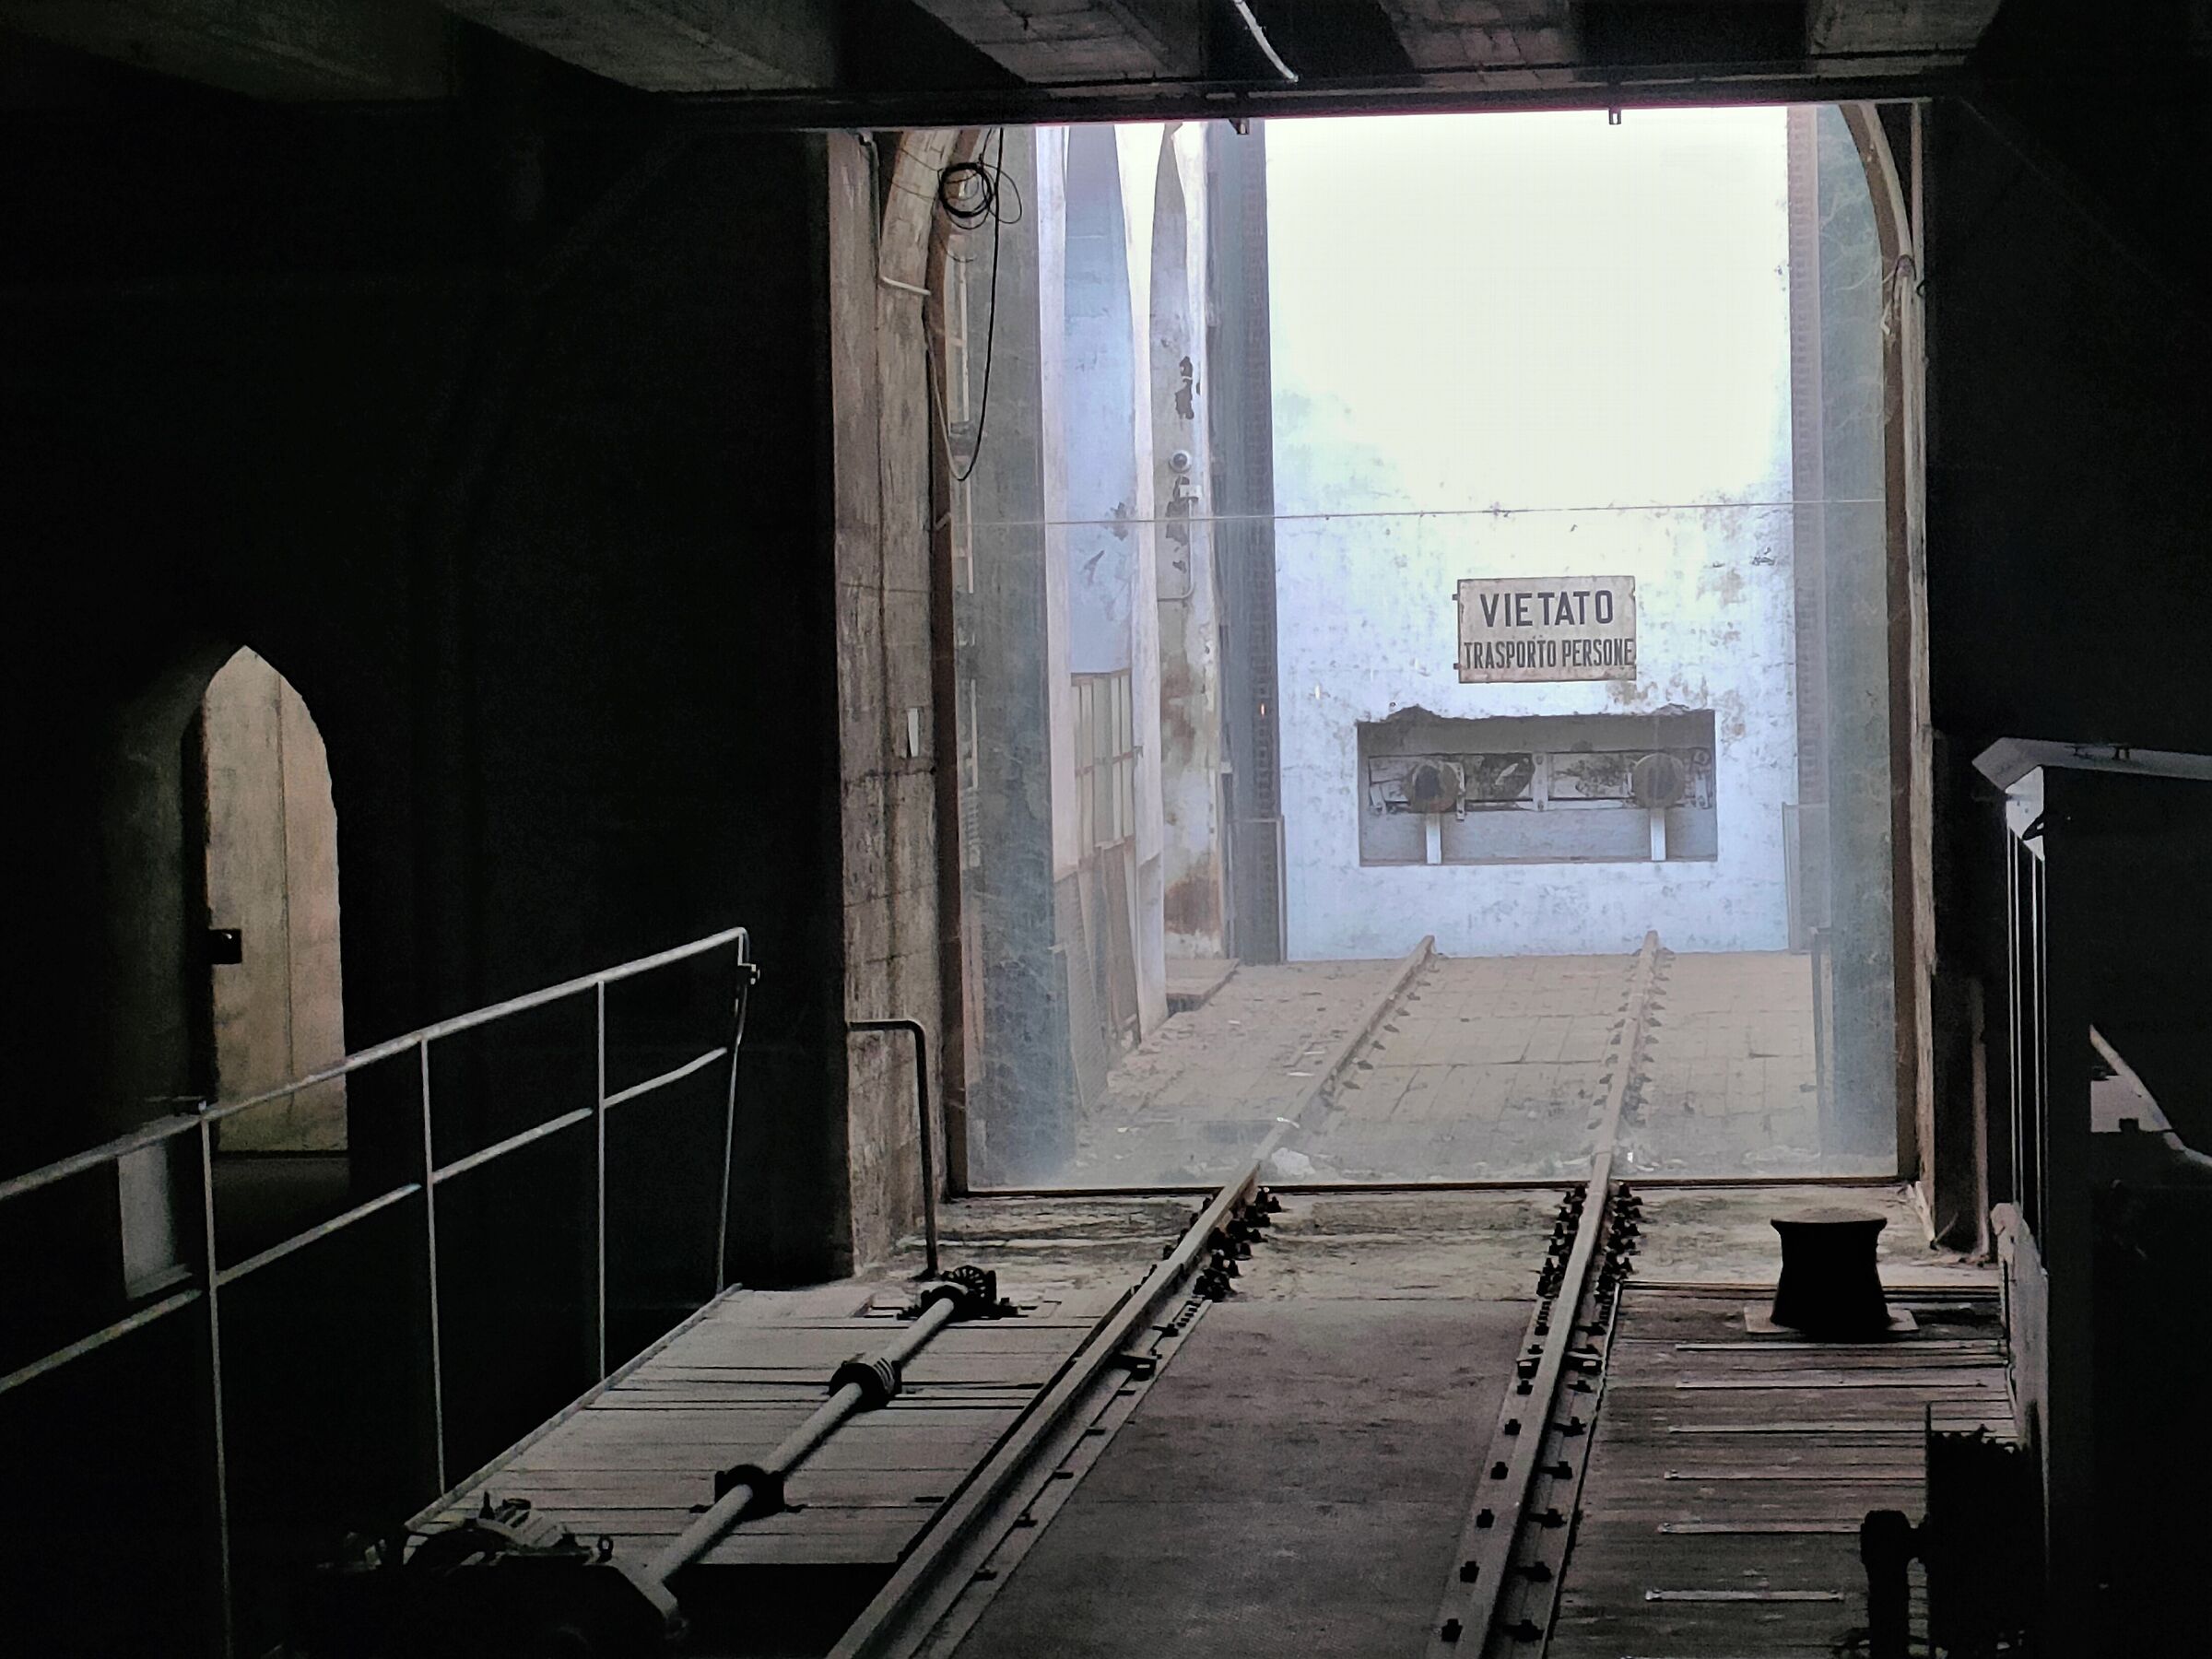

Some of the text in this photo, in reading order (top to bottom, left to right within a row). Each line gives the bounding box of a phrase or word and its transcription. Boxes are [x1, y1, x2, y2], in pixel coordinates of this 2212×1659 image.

[1479, 590, 1613, 628] VIETATO
[1464, 638, 1634, 669] TRASPORTO PERSONE
